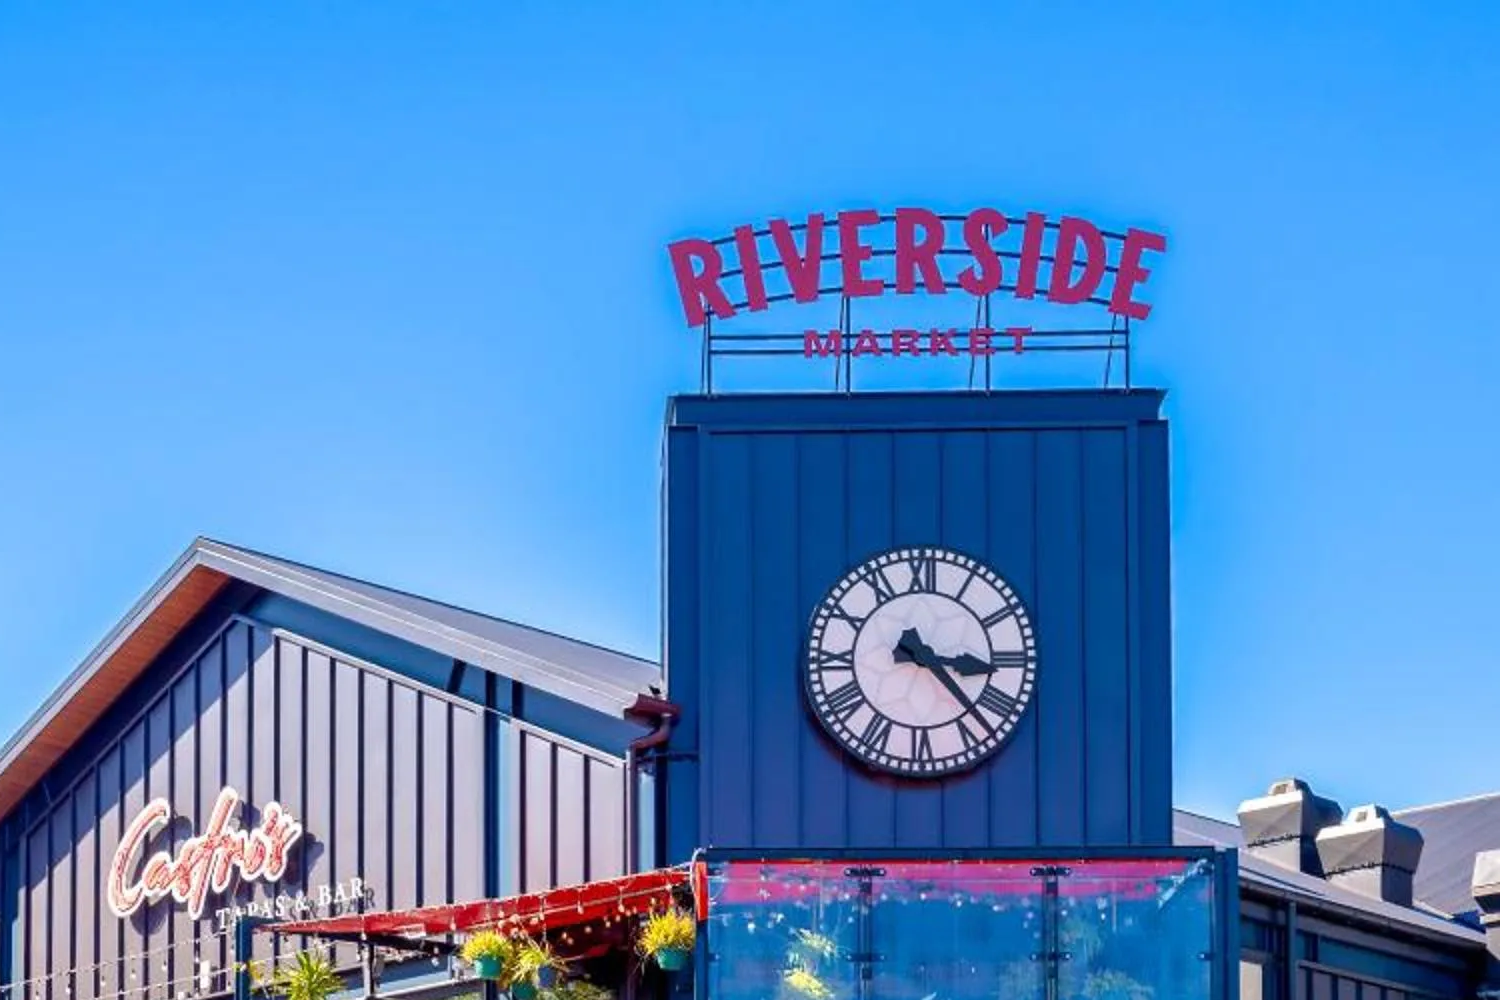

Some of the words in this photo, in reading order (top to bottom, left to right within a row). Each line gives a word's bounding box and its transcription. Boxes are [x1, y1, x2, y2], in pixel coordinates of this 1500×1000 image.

[668, 207, 1167, 328] RIVERSIDE
[803, 327, 1033, 358] MARKET
[108, 786, 302, 920] Castro's
[318, 877, 366, 907] BAR
